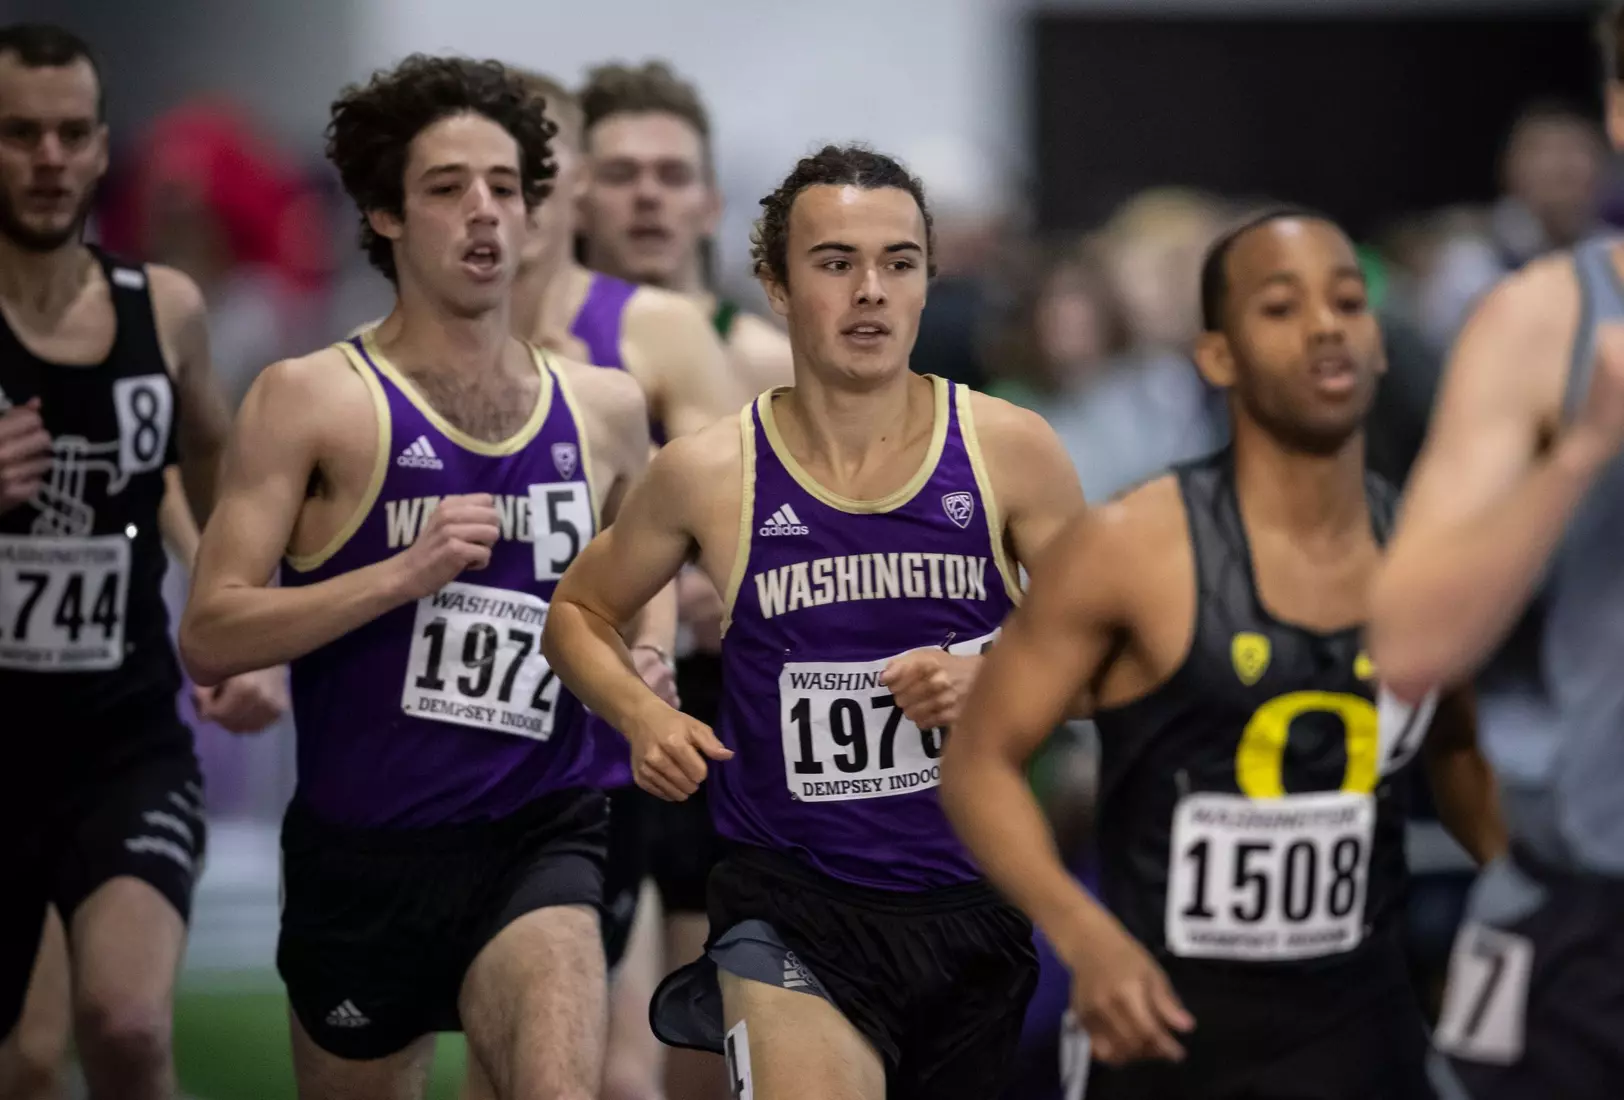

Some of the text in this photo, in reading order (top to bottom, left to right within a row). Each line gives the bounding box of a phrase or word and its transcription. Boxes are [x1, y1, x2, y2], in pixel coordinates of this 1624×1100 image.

[130, 385, 160, 462] 8
[397, 455, 444, 470] adidas
[546, 489, 580, 574] 5
[759, 522, 809, 537] adidas
[0, 571, 119, 641] 744
[754, 551, 988, 620] WASHINGTON
[789, 670, 887, 691] WASHIN
[418, 696, 497, 723] DEMPSEY
[803, 767, 941, 797] DEMPSEY INDOO
[1181, 836, 1361, 924] 1508
